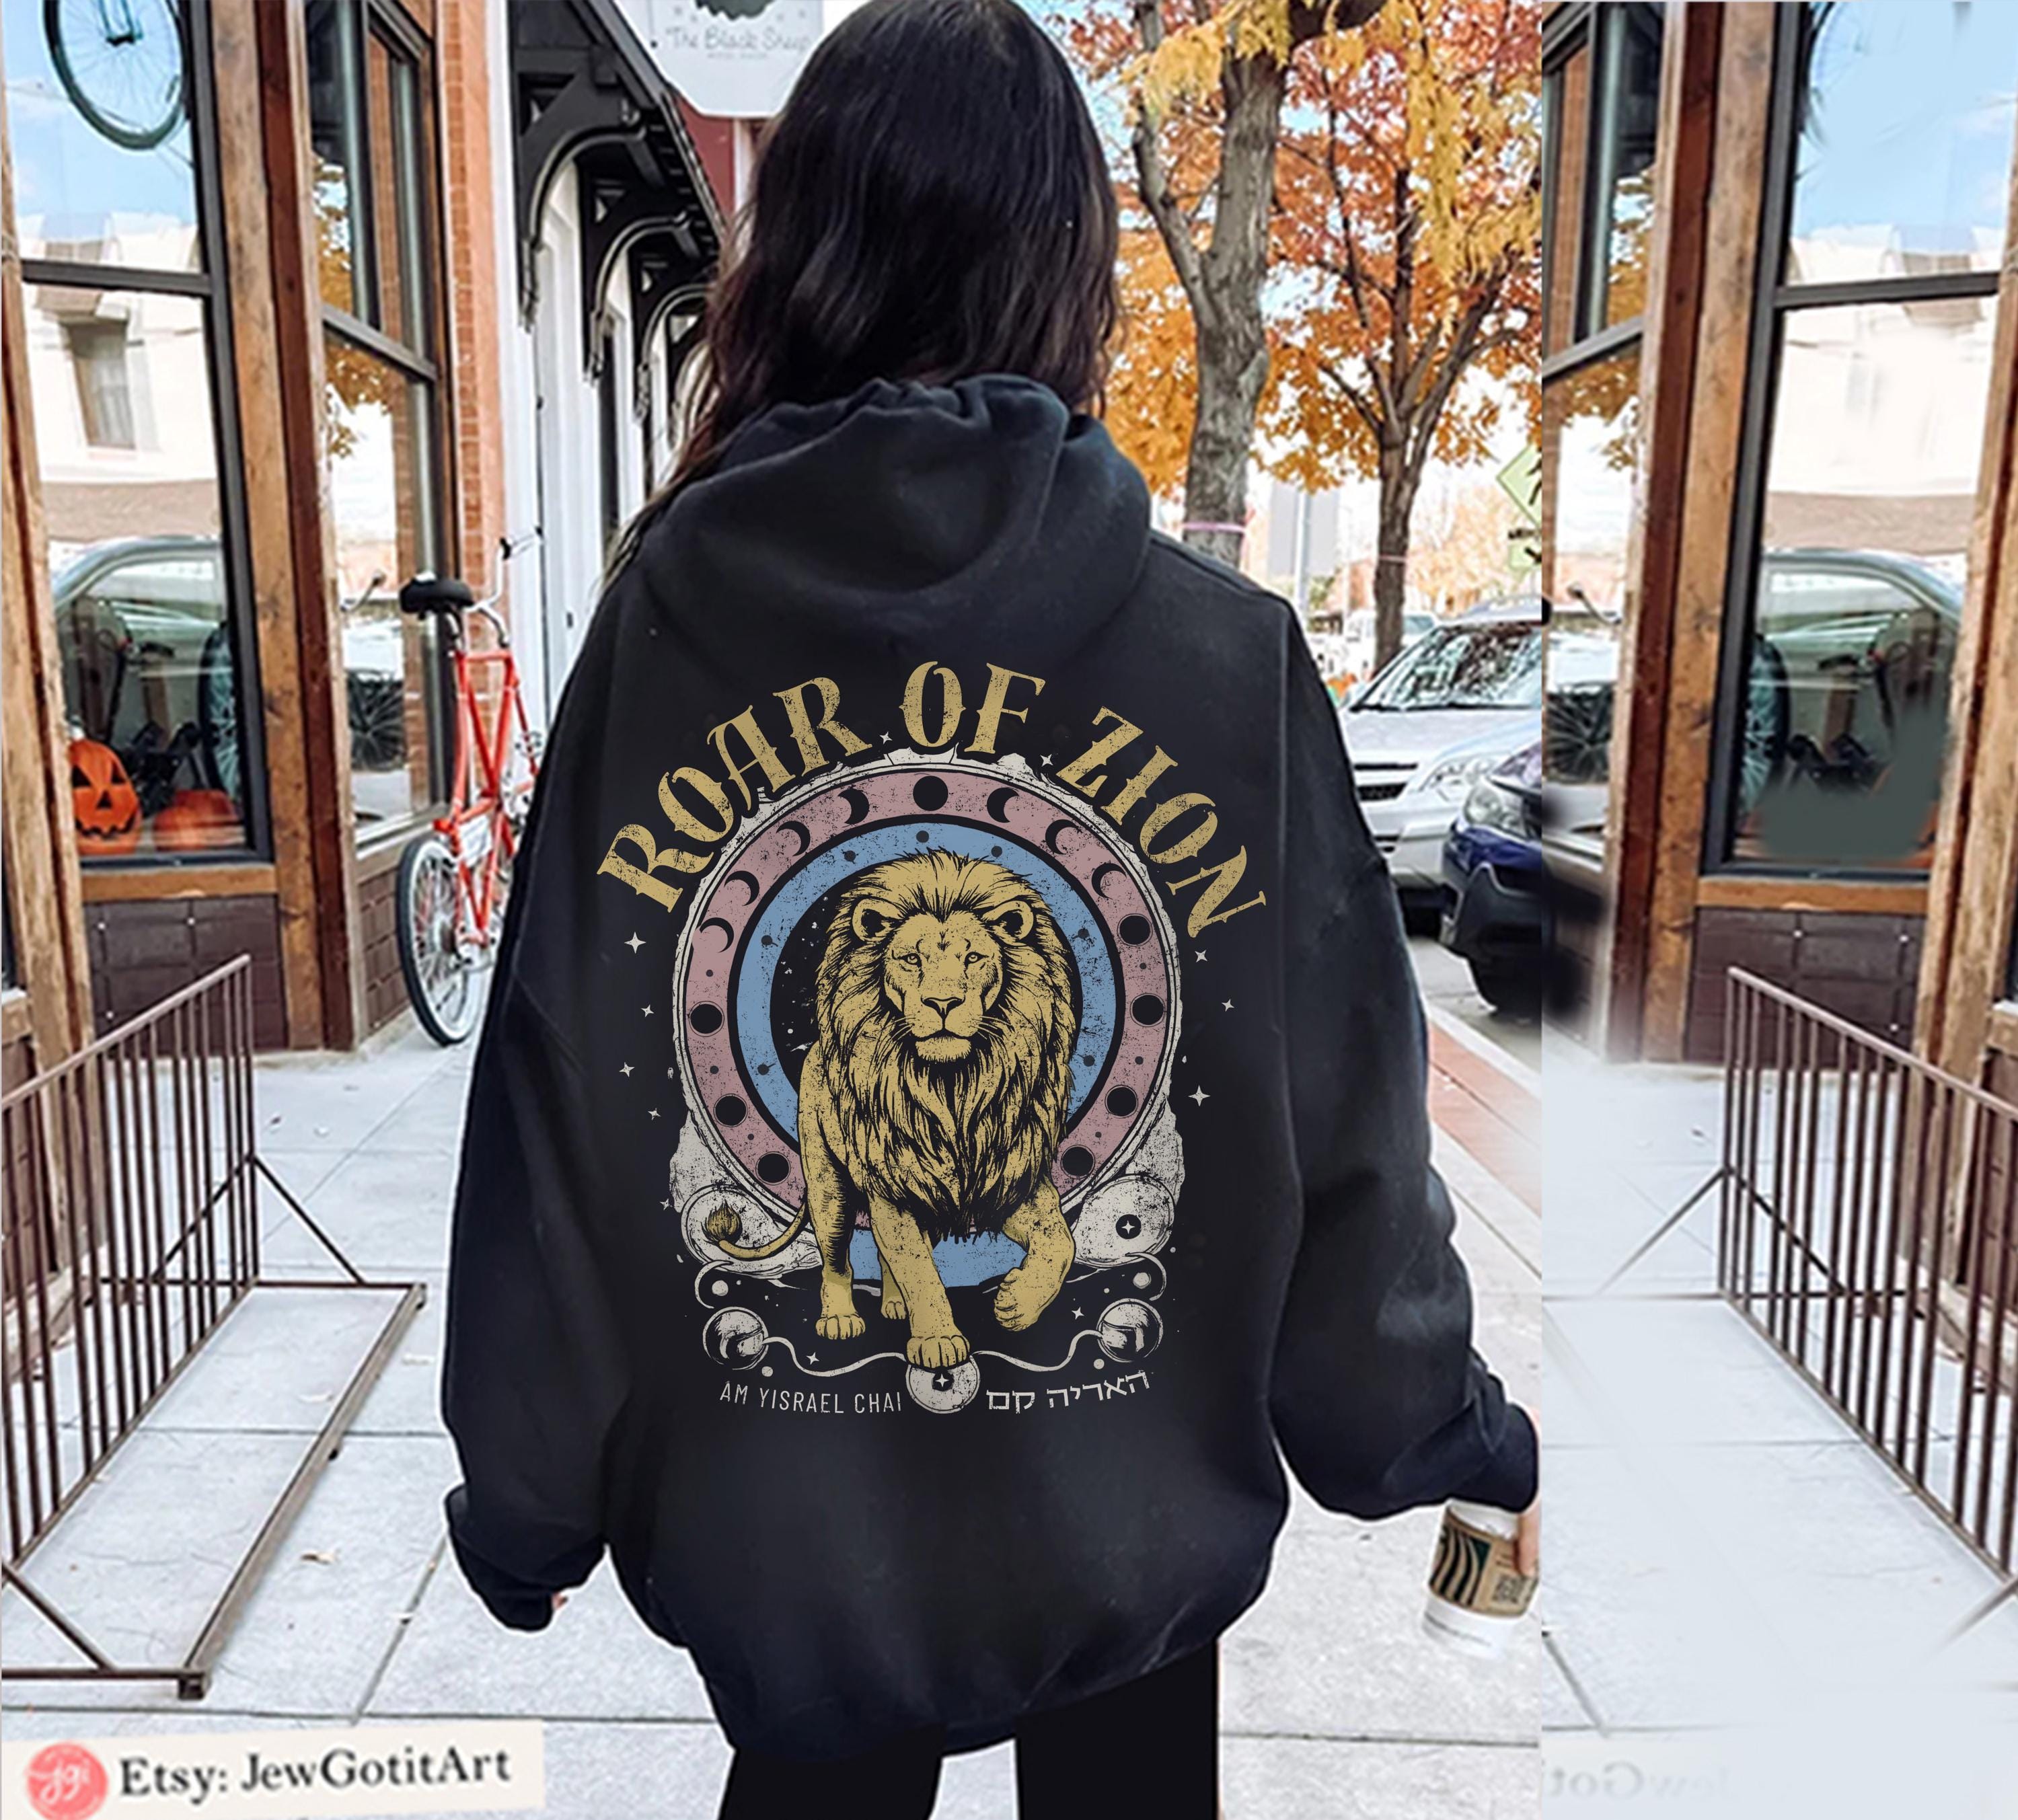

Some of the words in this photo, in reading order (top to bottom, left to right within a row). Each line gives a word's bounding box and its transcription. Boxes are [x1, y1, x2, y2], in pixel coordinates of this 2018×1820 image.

[666, 26, 698, 49] The
[705, 24, 757, 50] Black
[597, 676, 872, 913] ROAR
[898, 660, 1047, 755] OF
[1056, 706, 1268, 939] ZION
[719, 1382, 749, 1406] AM
[759, 1388, 845, 1414] YISRAEL
[854, 1391, 902, 1414] CHAI
[985, 1390, 1035, 1414] קם
[1046, 1369, 1150, 1408] האריה
